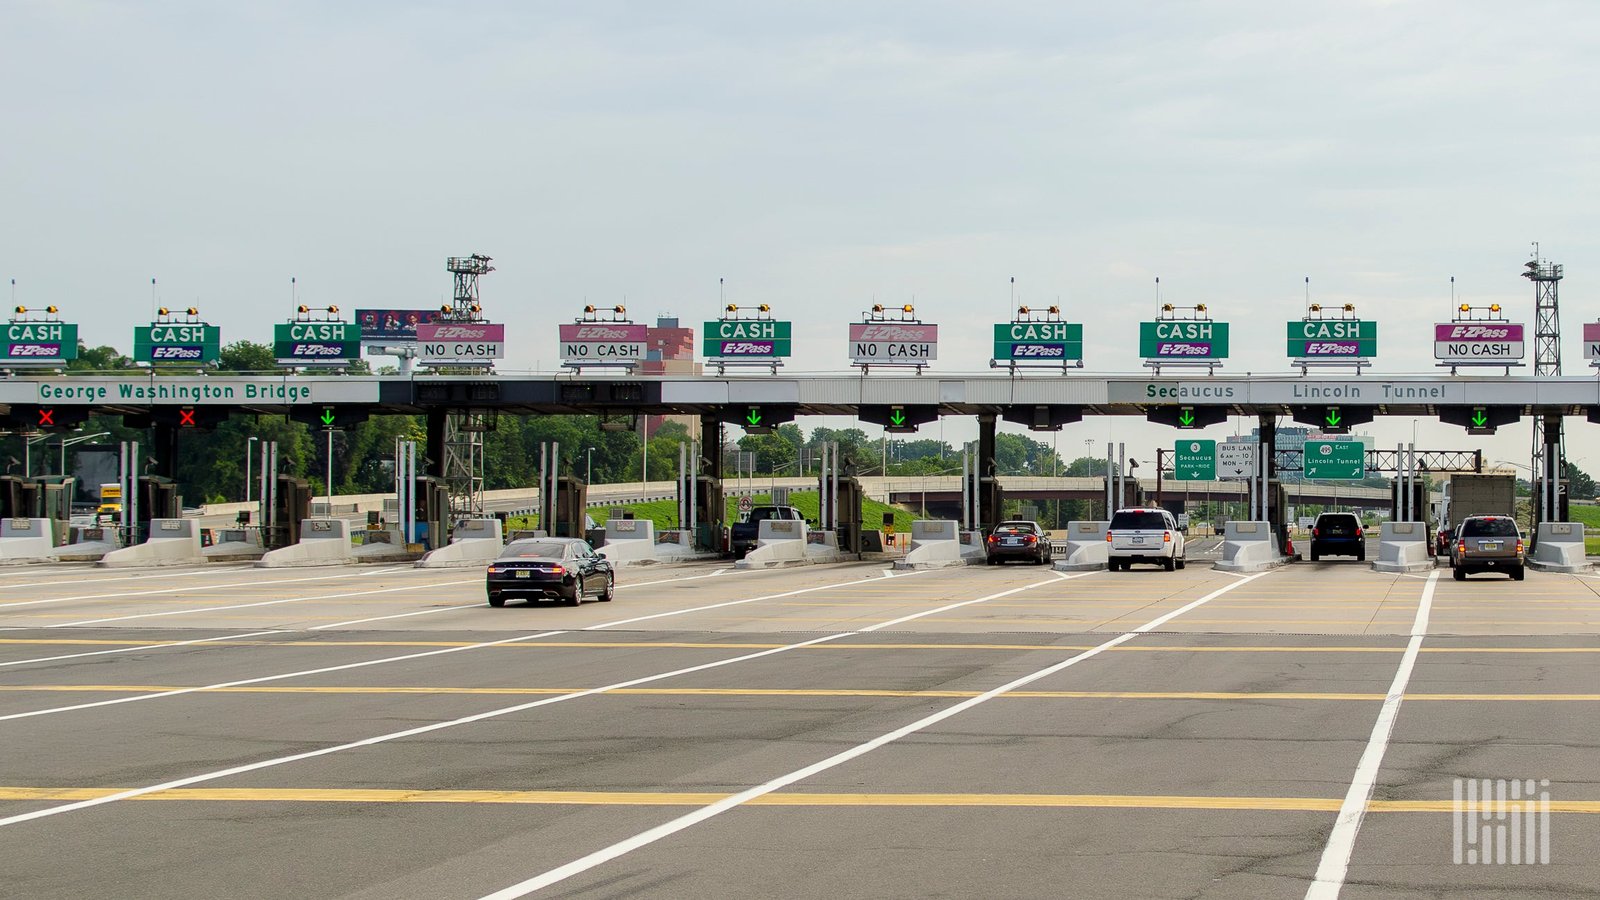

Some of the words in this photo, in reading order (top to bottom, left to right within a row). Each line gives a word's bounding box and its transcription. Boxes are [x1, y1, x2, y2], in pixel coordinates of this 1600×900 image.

[8, 326, 62, 341] CASH
[150, 327, 205, 342] CASH
[290, 325, 345, 341] CASH
[719, 323, 775, 338] CASH
[1010, 325, 1067, 340] CASH
[1156, 323, 1212, 339] CASH
[1303, 323, 1360, 338] CASH
[425, 344, 446, 356] NO
[454, 344, 496, 356] CASH
[567, 344, 588, 356] NO
[597, 344, 639, 356] CASH
[857, 343, 877, 356] NO
[887, 343, 929, 357] CASH
[1448, 344, 1468, 355] NO
[1471, 344, 1510, 355] CASH
[40, 384, 107, 402] George
[118, 384, 234, 402] Washington
[245, 384, 310, 402] Bridge
[1146, 384, 1234, 398] Secaucus
[1293, 384, 1361, 398] Lincoln
[1381, 384, 1446, 398] Tunnel
[1321, 446, 1330, 454] 495
[1556, 485, 1566, 495] 2
